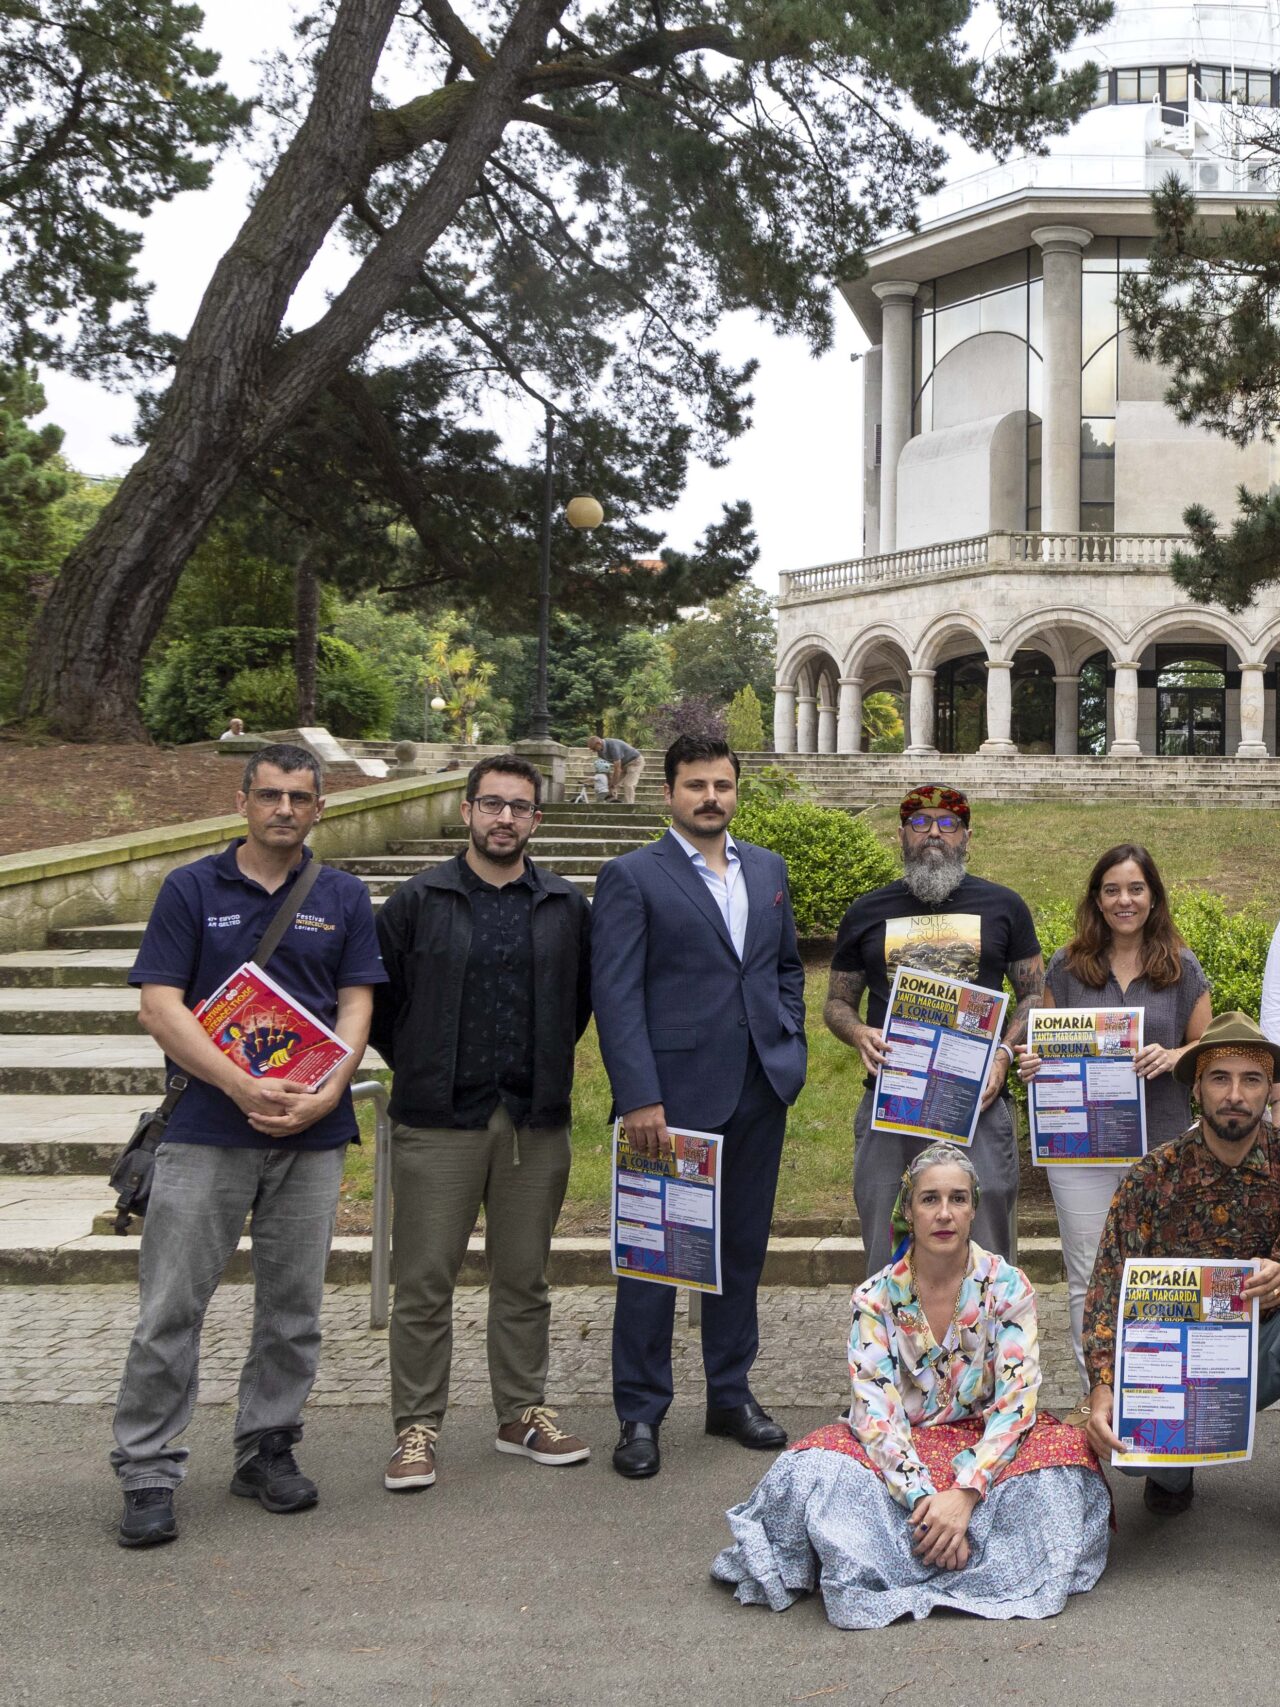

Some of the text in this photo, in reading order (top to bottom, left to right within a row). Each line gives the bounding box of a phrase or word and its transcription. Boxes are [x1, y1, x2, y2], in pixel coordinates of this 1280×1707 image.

[296, 912, 325, 923] Festival
[911, 915, 948, 928] NOITE
[899, 976, 957, 1002] ROMARÍA
[897, 991, 955, 1013] SANTA MARGARIDA
[203, 1000, 229, 1027] ESTIVAL
[1035, 1014, 1093, 1030] ROMARÍA
[1056, 1032, 1093, 1042] MARGARIDA
[1036, 1044, 1044, 1054] A
[1129, 1268, 1197, 1287] ROMARÍA
[1128, 1288, 1198, 1303] SANTA MARGARIDA
[1129, 1301, 1193, 1317] A CORUÑA
